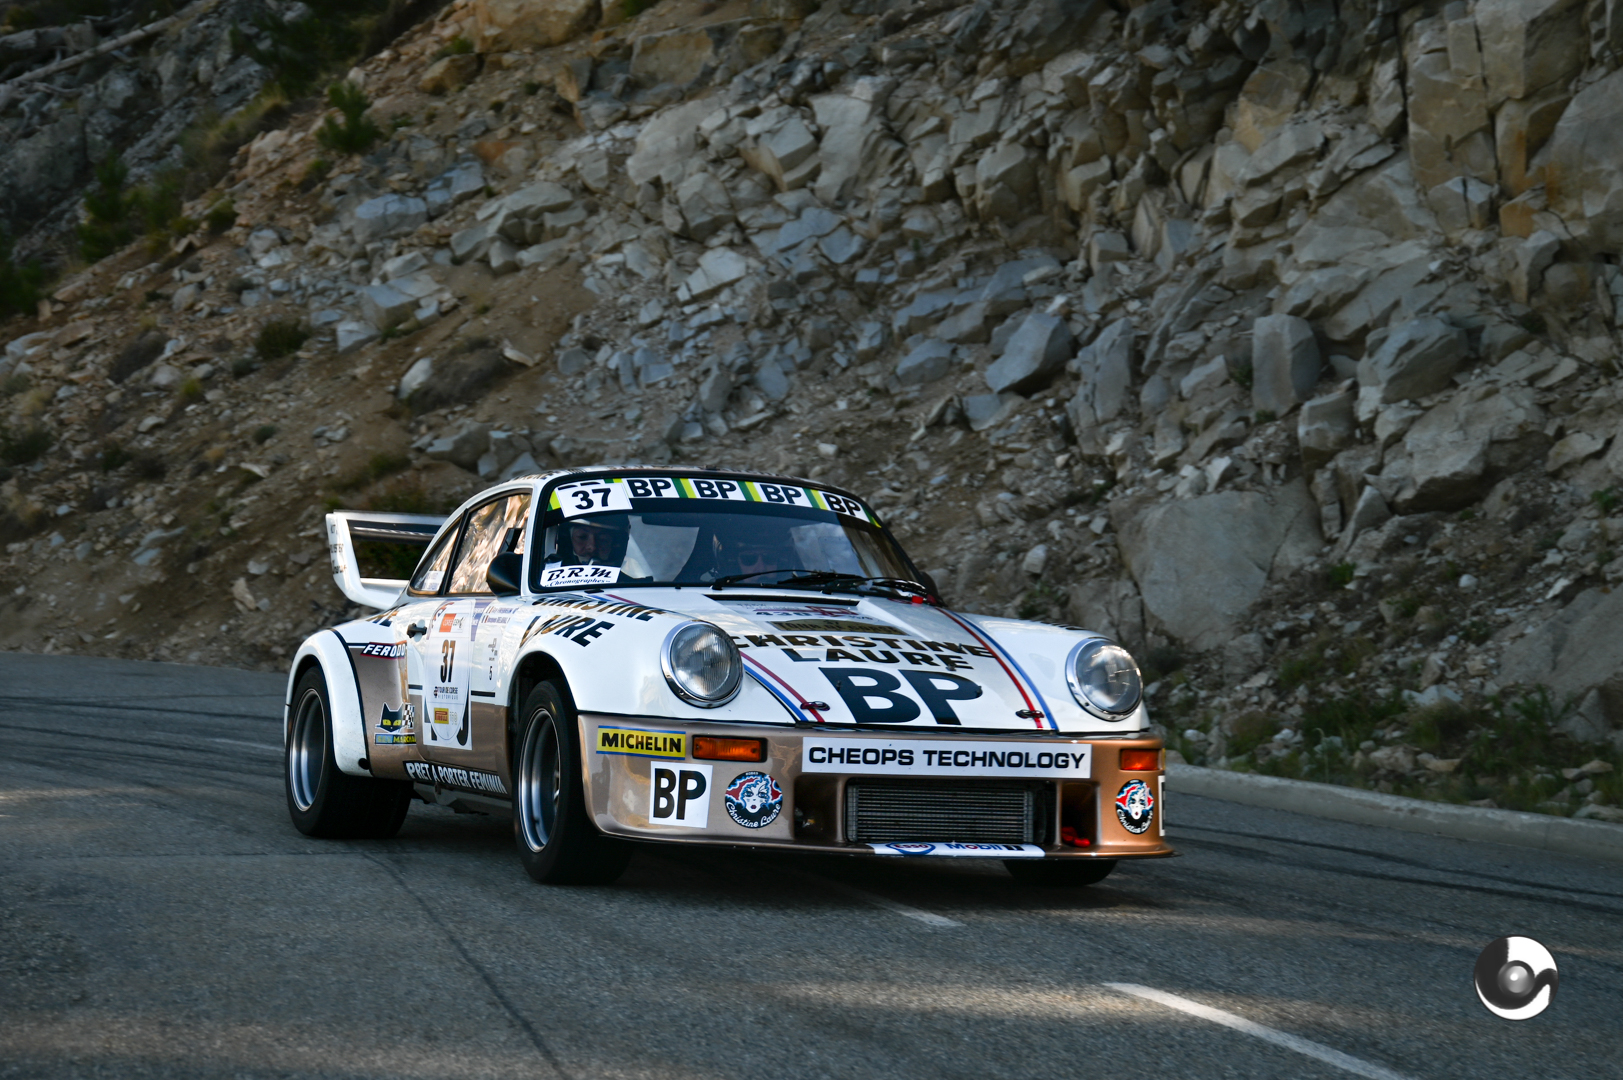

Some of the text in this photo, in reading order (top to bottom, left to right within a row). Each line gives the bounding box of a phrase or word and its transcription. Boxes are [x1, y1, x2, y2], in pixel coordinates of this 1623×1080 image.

[571, 487, 612, 510] 37
[626, 479, 861, 516] BP BP BP BP
[440, 639, 457, 684] 37
[780, 648, 975, 671] LAURE
[818, 666, 984, 726] BP
[601, 732, 682, 753] MICHELIN
[808, 746, 1086, 769] CHEOPS TECHNOLOGY
[405, 762, 432, 781] PRET
[437, 765, 472, 788] PORTER
[653, 768, 707, 820] BP
[726, 802, 782, 829] Christine Laure
[944, 842, 1001, 851] Mobil
